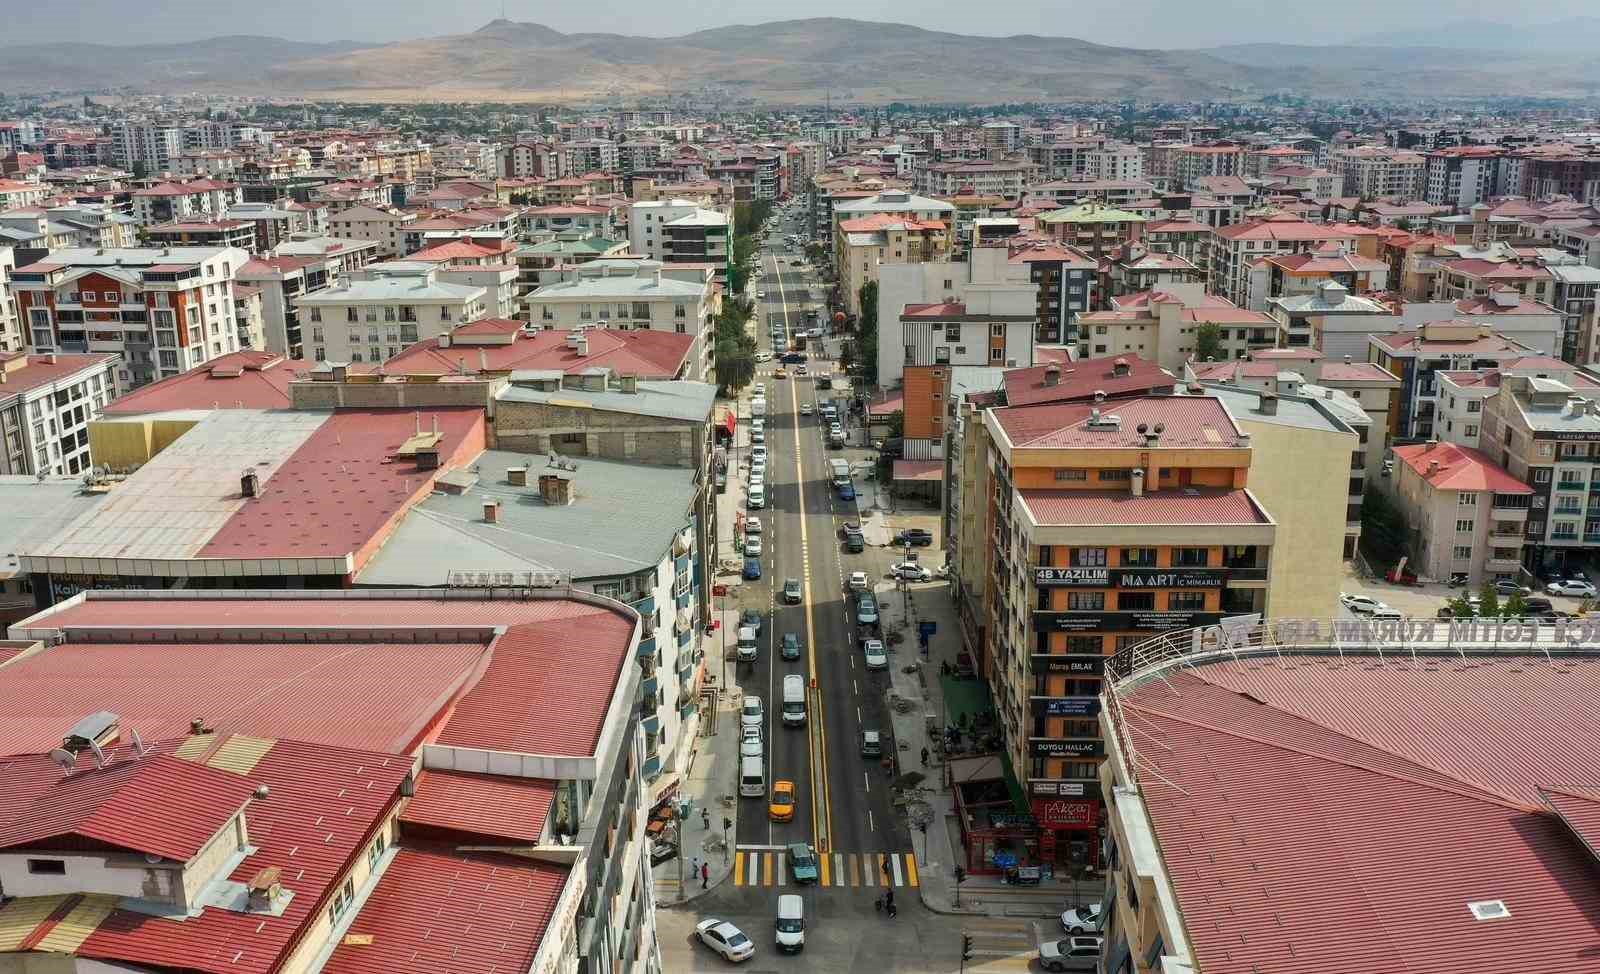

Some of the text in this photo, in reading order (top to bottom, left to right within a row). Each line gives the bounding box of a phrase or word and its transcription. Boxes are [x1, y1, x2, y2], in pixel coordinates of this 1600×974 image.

[1038, 569, 1107, 579] 4B YAZILIM
[1071, 663, 1093, 671] EMLAK
